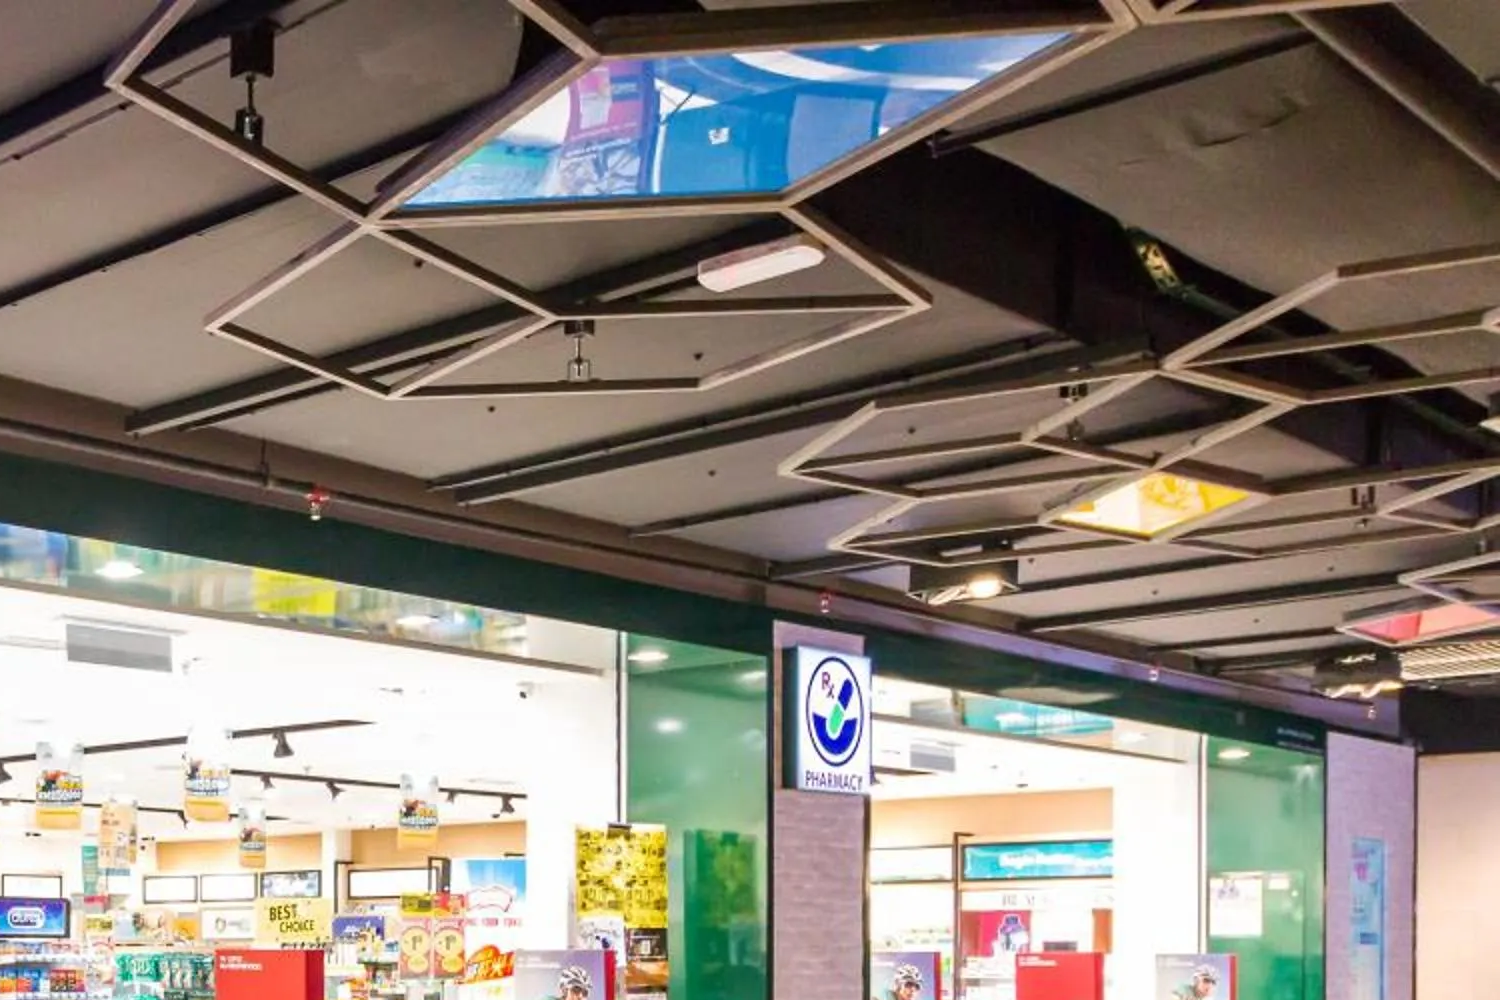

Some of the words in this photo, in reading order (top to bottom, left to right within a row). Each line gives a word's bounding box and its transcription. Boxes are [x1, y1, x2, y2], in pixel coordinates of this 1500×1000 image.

[805, 770, 864, 792] PHARMACY
[269, 904, 298, 921] BEST
[280, 920, 315, 933] CHOICE
